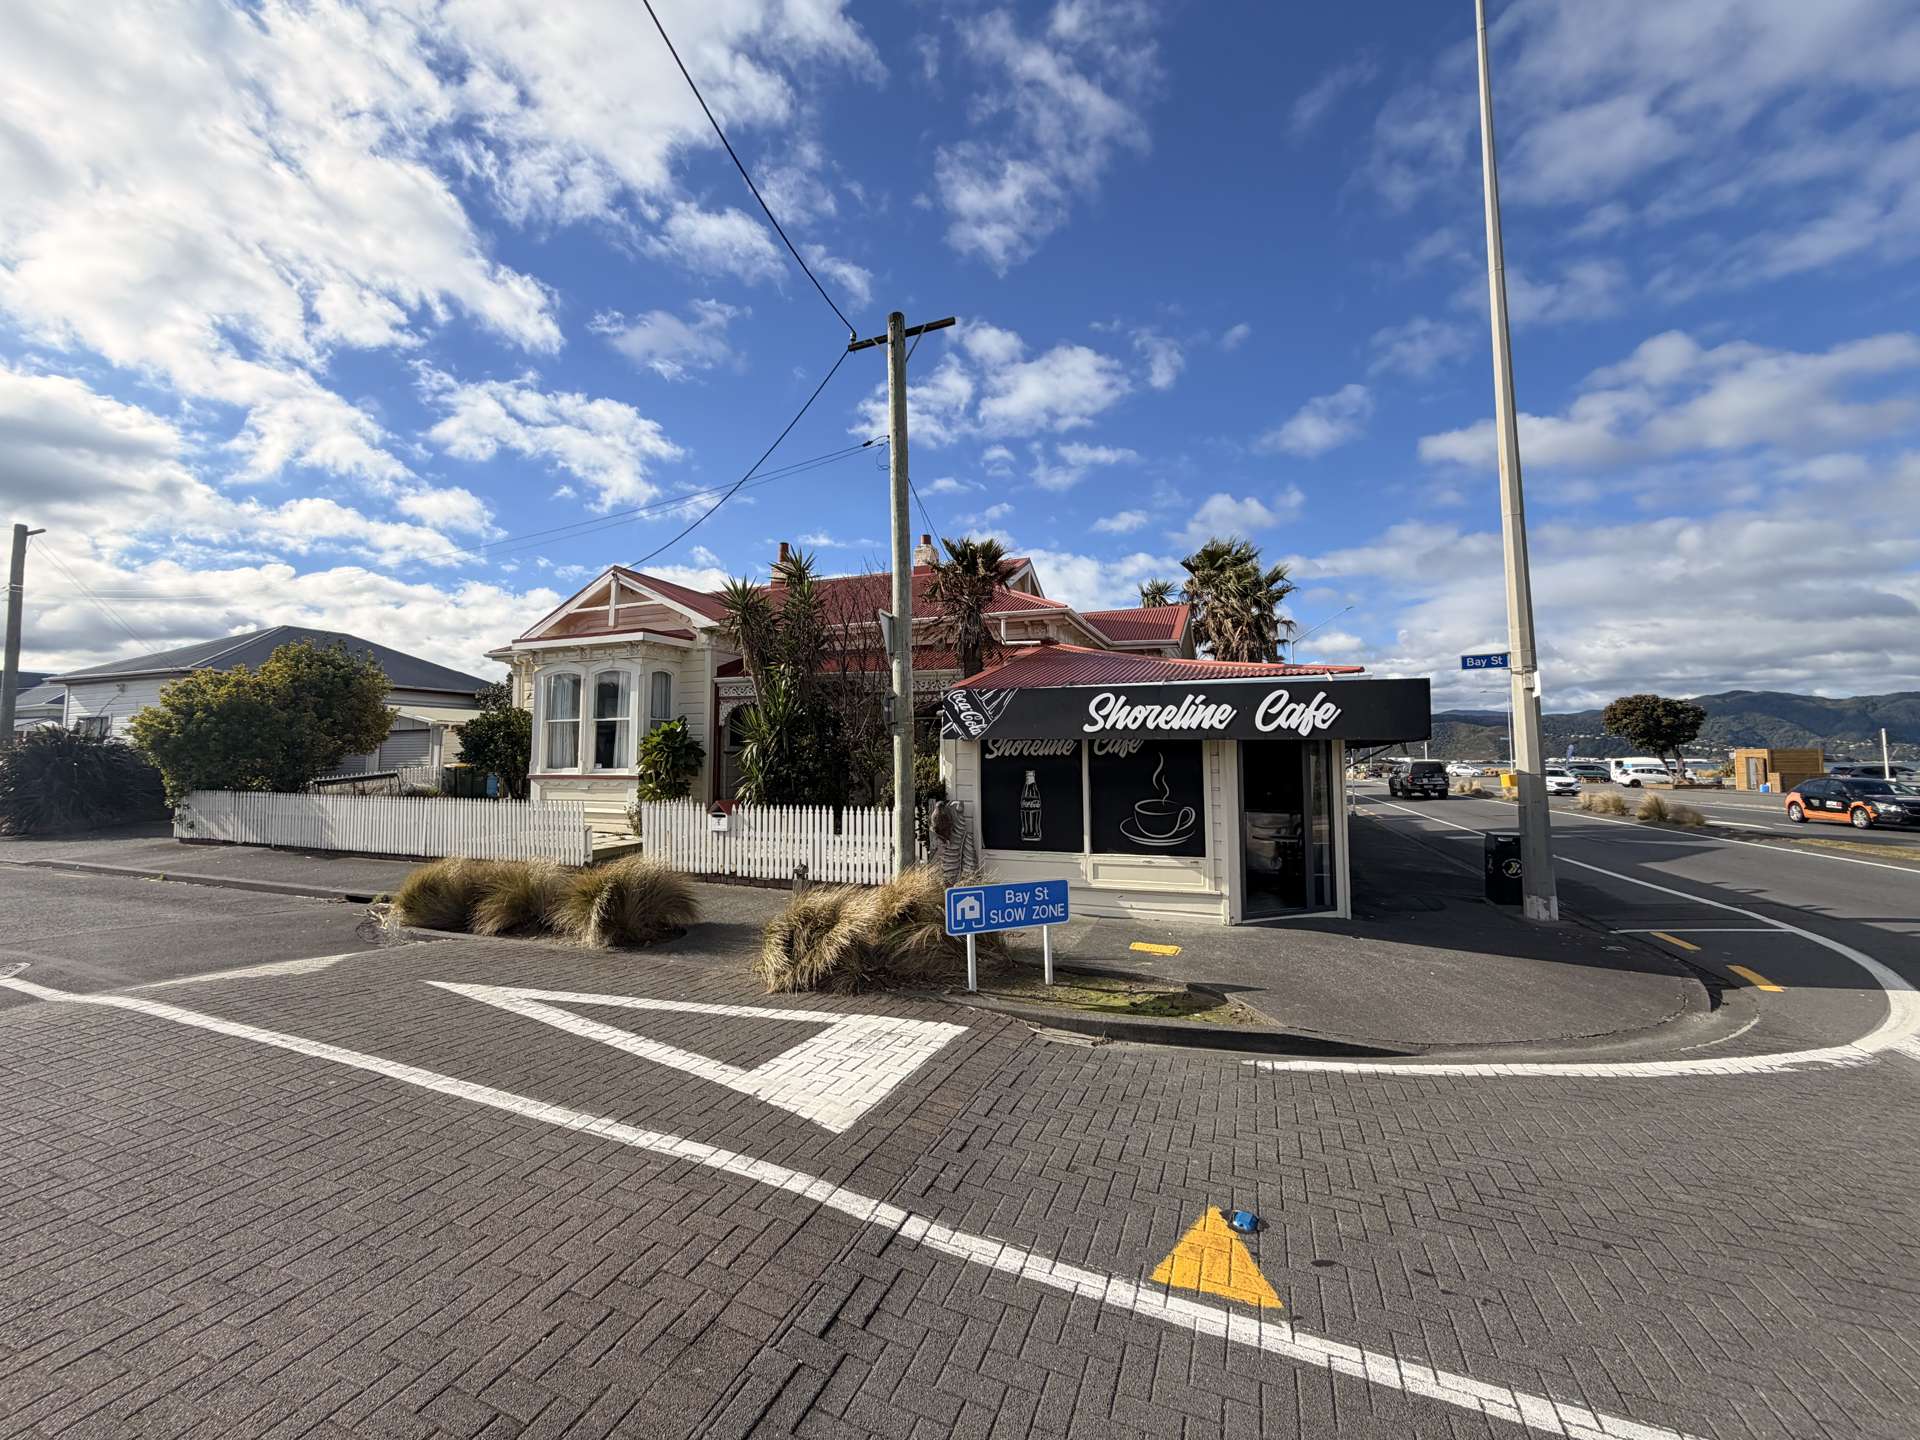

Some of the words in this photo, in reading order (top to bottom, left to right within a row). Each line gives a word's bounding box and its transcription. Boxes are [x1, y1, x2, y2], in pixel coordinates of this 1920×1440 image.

[1466, 657, 1487, 668] Bay
[1491, 655, 1503, 665] St
[947, 689, 988, 735] Coca-Cola
[1083, 692, 1237, 733] Shoreline
[1255, 689, 1342, 737] Cafe
[1005, 890, 1031, 905] Bay
[1034, 886, 1049, 901] St
[989, 907, 1026, 924] SLOW
[1032, 903, 1065, 920] ZONE
